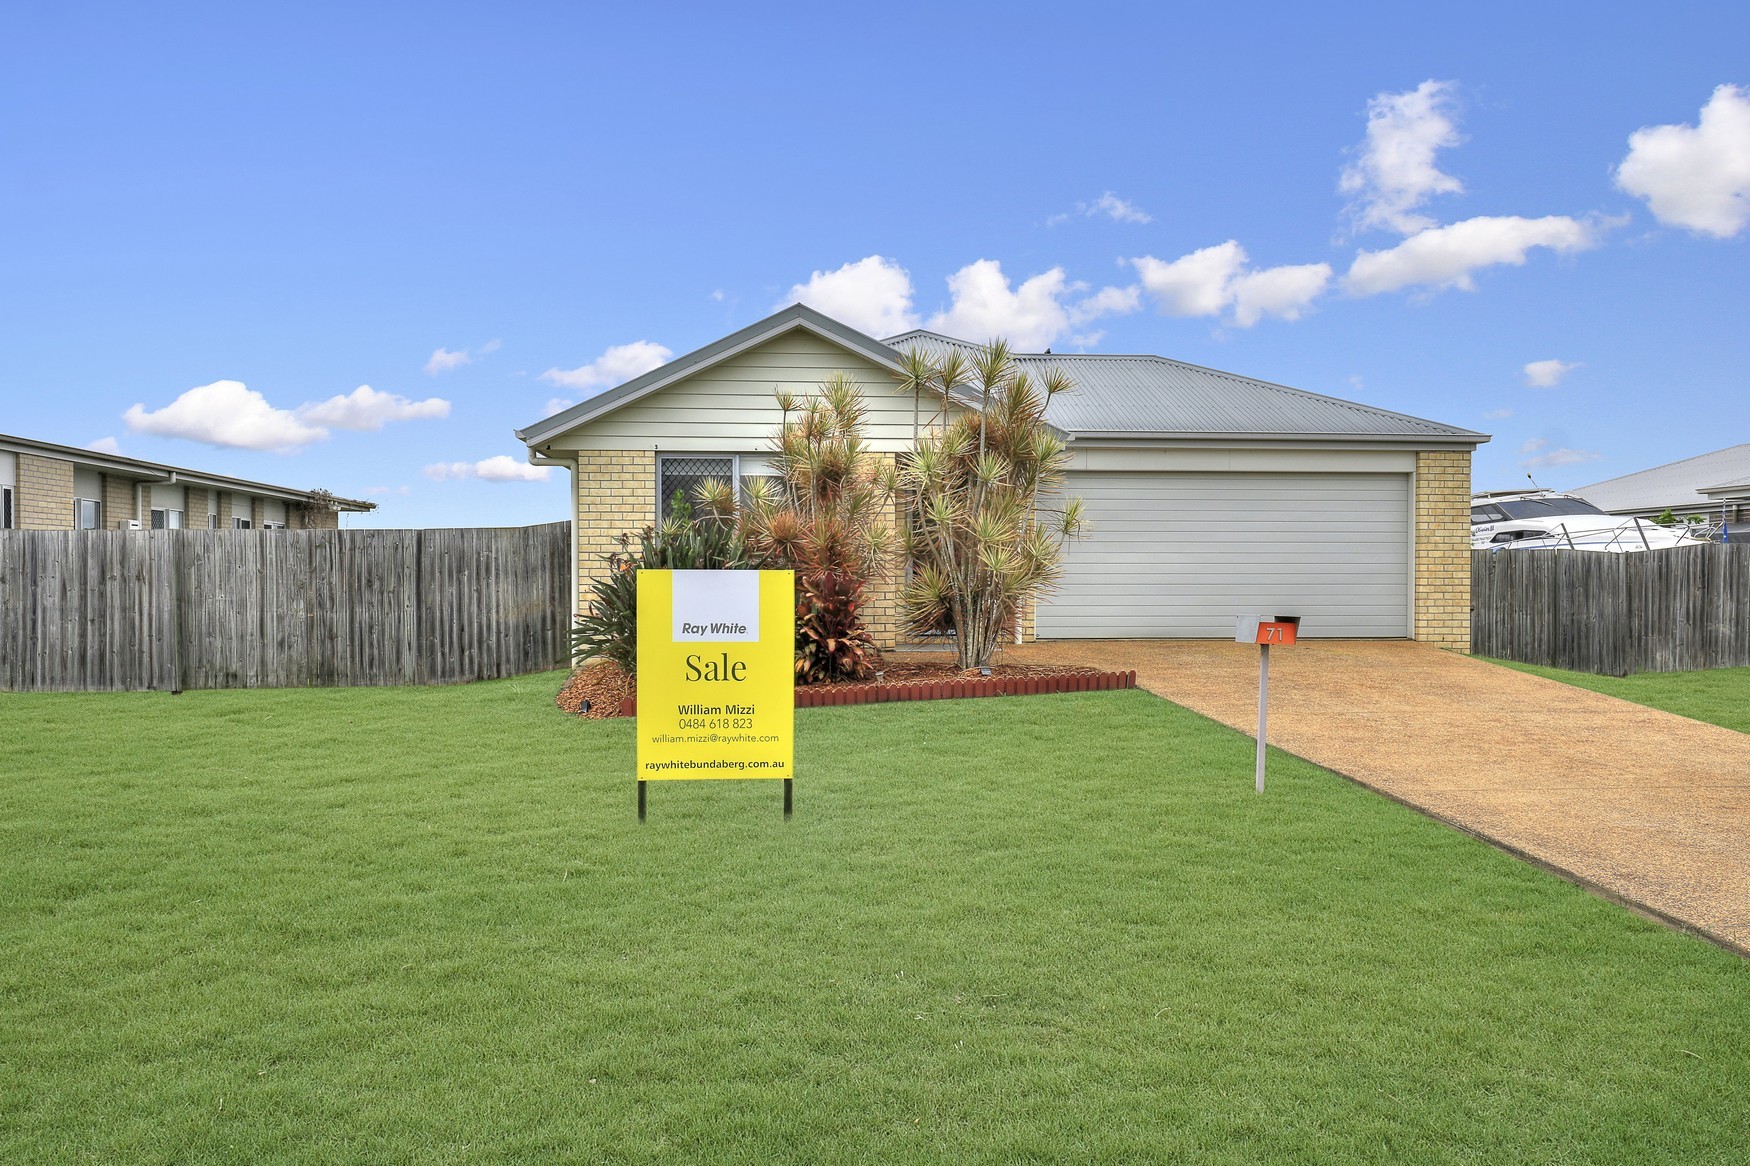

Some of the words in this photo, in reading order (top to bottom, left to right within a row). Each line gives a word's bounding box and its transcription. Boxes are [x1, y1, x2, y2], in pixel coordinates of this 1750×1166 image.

[682, 623, 708, 636] Ray
[710, 623, 747, 634] White
[1266, 627, 1283, 641] 71
[686, 652, 747, 682] Sale
[678, 705, 721, 715] William
[725, 704, 755, 715] Mizzi
[679, 719, 706, 729] 0484
[709, 719, 730, 729] 618
[732, 718, 753, 729] 823
[652, 733, 779, 744] william.mizzi@raywhite.com
[645, 760, 785, 772] raywhitebundaberg.com.au
